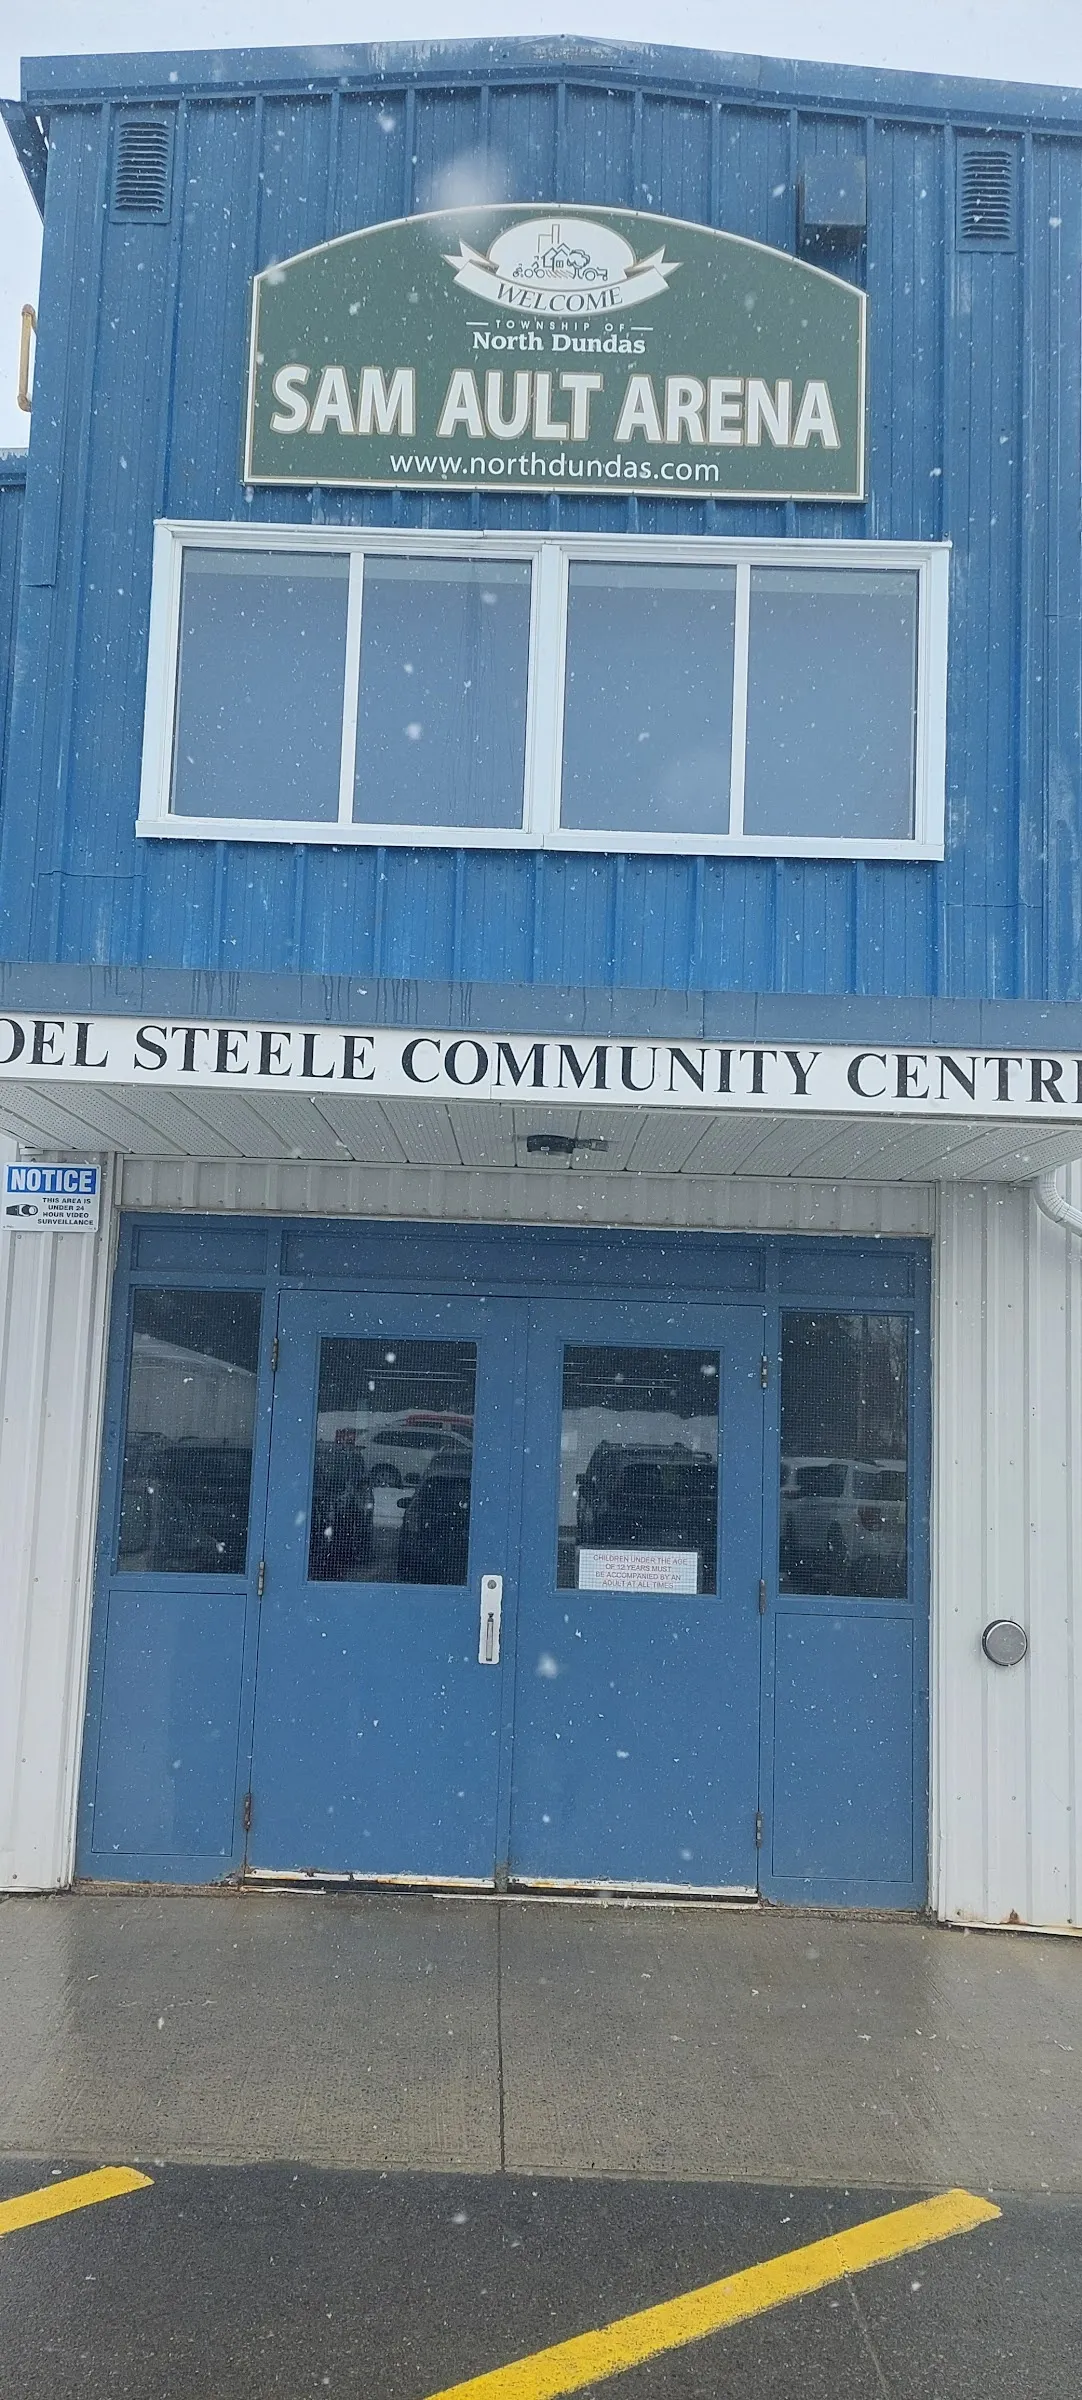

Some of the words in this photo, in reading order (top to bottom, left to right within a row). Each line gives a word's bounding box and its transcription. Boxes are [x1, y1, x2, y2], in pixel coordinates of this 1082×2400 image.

[497, 283, 623, 312] WELCOME
[495, 319, 590, 332] TOWNSHIP
[604, 323, 625, 333] OF
[472, 331, 545, 351] North
[551, 333, 646, 354] Dundas
[270, 364, 416, 436] SAM
[437, 369, 602, 441] AULT
[614, 375, 840, 449] ARENA
[390, 452, 720, 482] www.northdundas.com
[133, 1025, 376, 1081] STEELE
[401, 1038, 822, 1096] COMMUNITY
[11, 1168, 93, 1193] NOTICE
[37, 1218, 94, 1226] SURVEILLANCE
[593, 1554, 629, 1563] CHILDREN
[630, 1555, 656, 1564] UNDER
[657, 1557, 671, 1565] THE
[672, 1558, 688, 1566] AGE
[626, 1564, 650, 1572] YEARS
[651, 1565, 672, 1573] MUST
[606, 1571, 659, 1580] ACCOMPANIED
